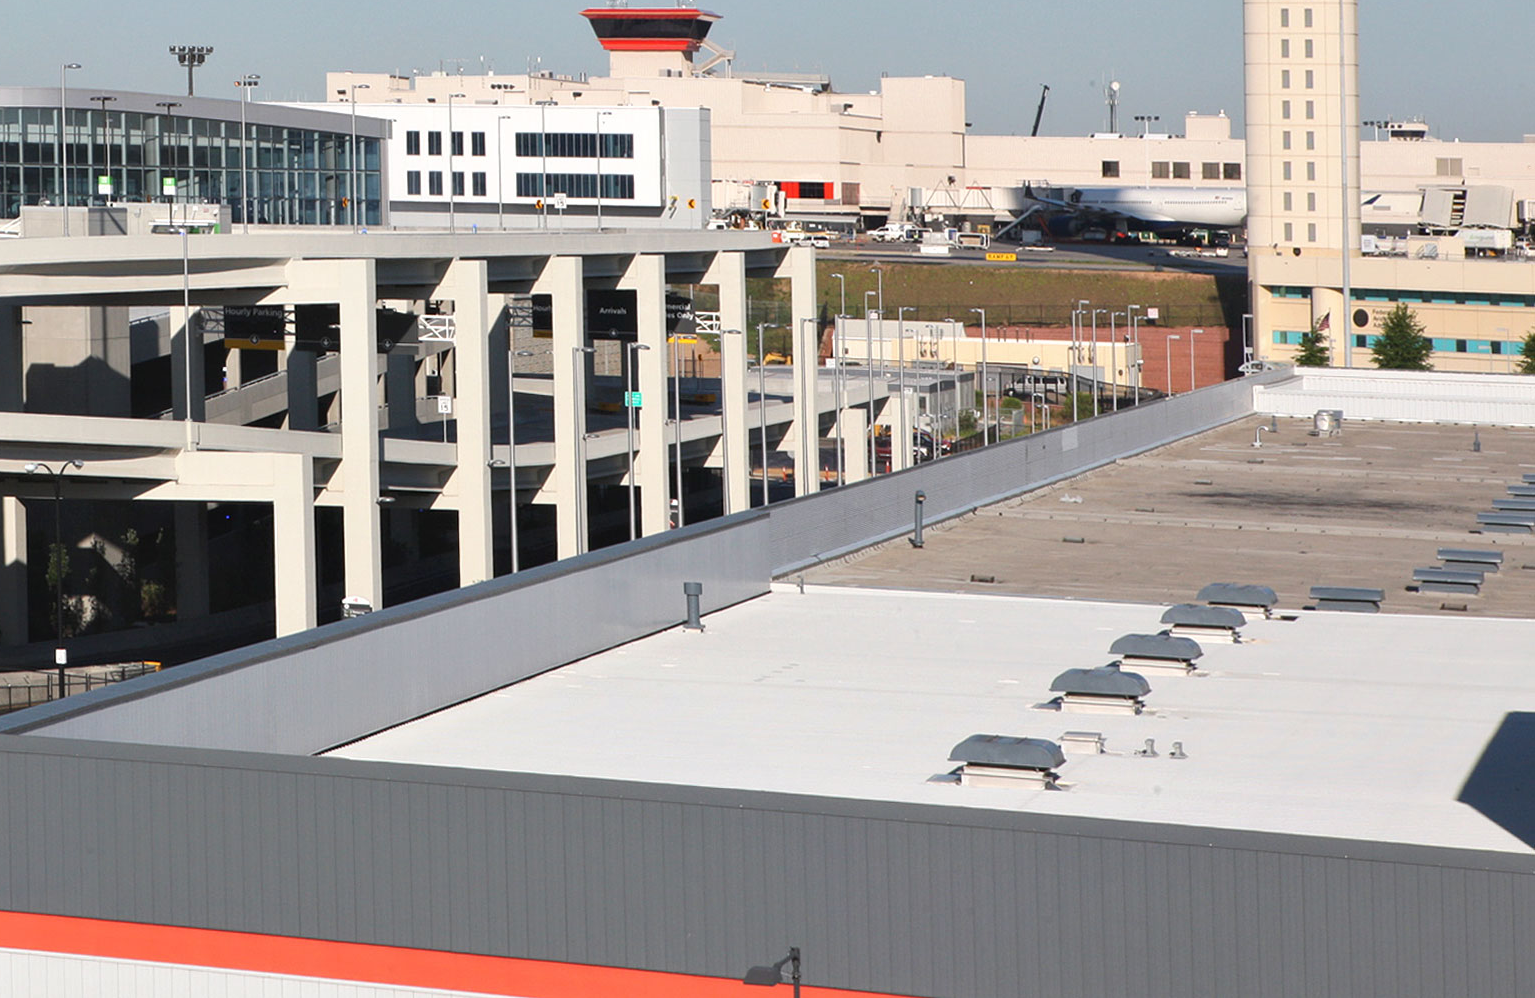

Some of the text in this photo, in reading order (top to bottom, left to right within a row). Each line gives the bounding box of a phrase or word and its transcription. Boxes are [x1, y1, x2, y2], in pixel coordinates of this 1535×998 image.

[599, 307, 627, 315] Arrivals
[666, 303, 691, 311] mercial
[225, 307, 283, 319] Hourly Parking
[676, 312, 694, 321] Only
